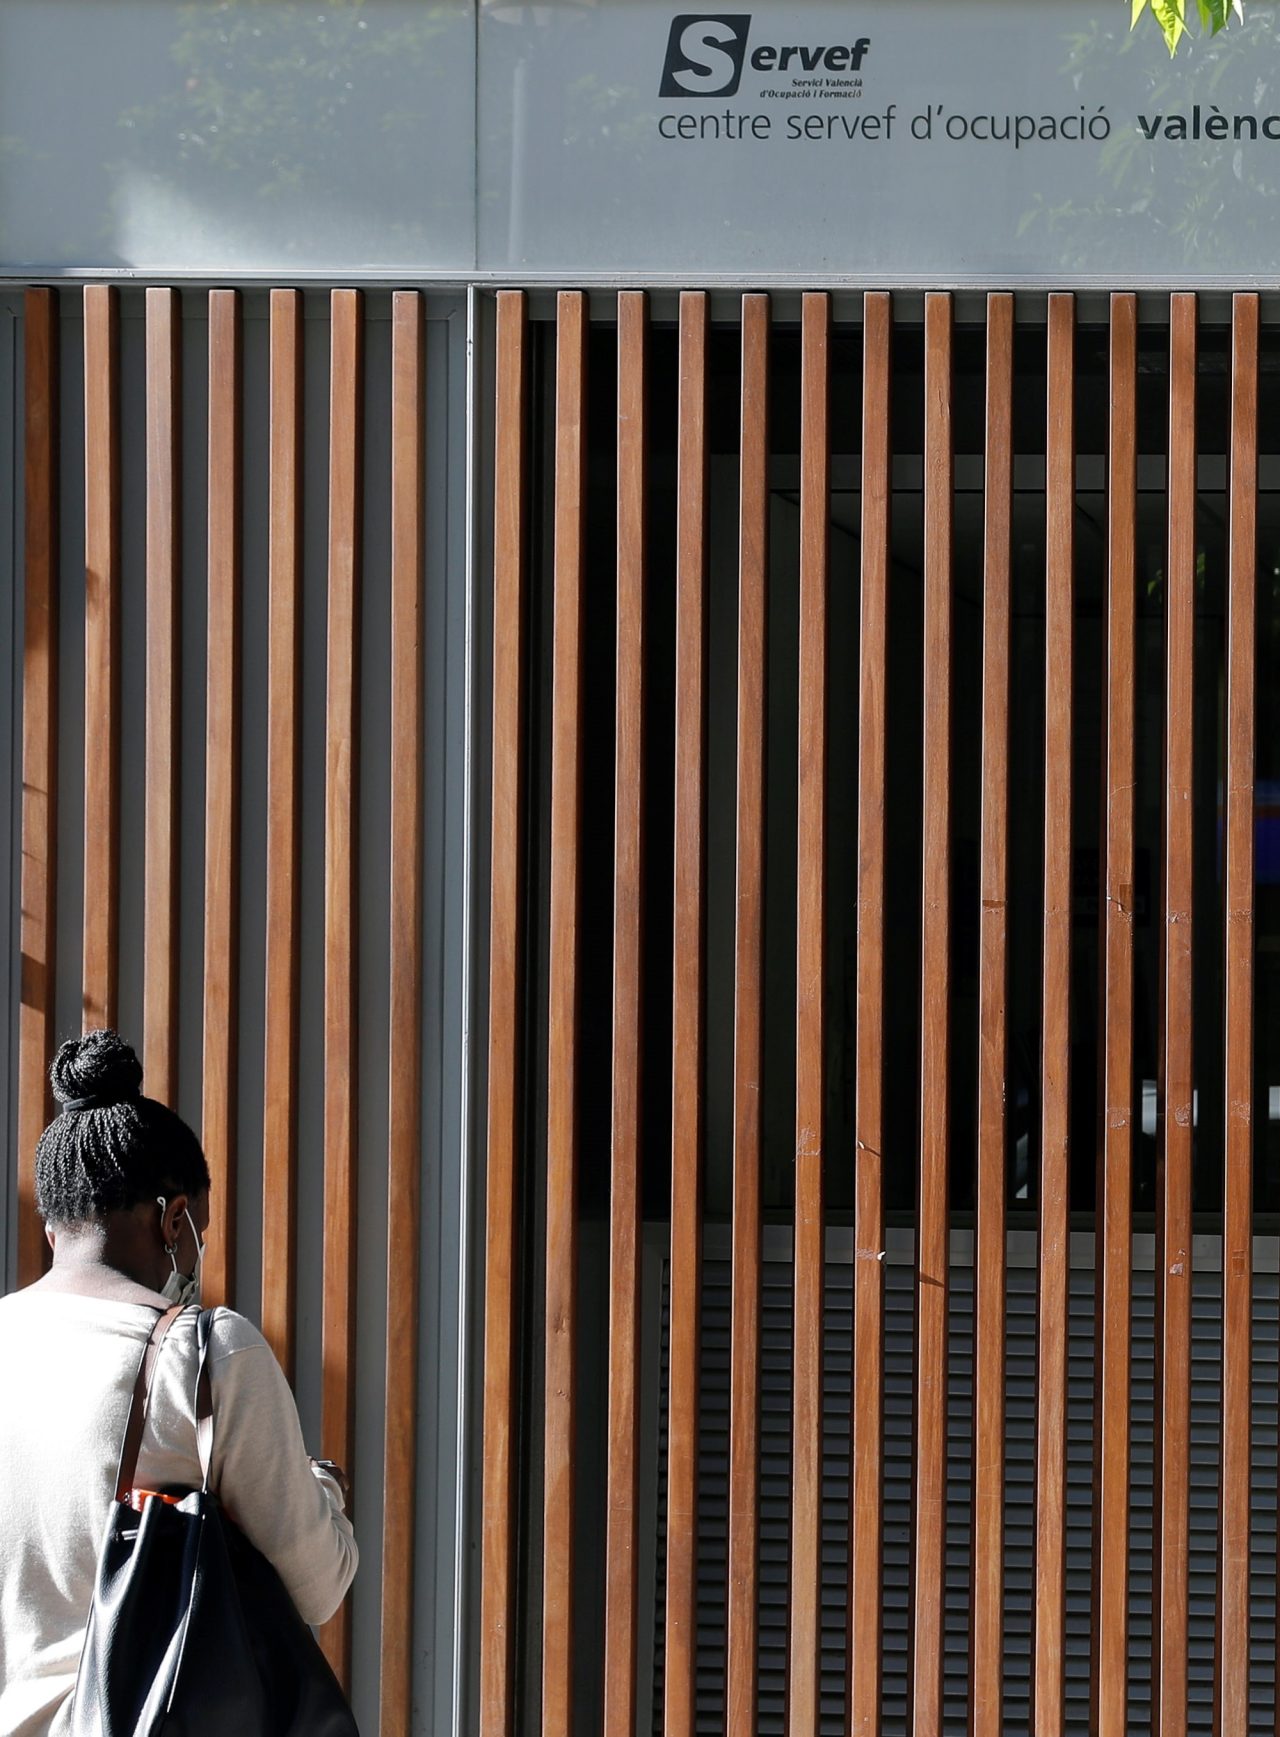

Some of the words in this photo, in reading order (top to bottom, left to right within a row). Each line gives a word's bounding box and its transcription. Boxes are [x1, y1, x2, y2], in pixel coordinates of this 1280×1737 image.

[664, 16, 871, 96] Servef
[759, 89, 811, 100] d'Ocupació
[818, 89, 862, 98] Formació
[791, 78, 823, 88] Servici
[825, 78, 863, 87] Valencià
[658, 109, 772, 140] centre
[786, 104, 897, 140] servef
[910, 104, 1111, 150] d'ocupació
